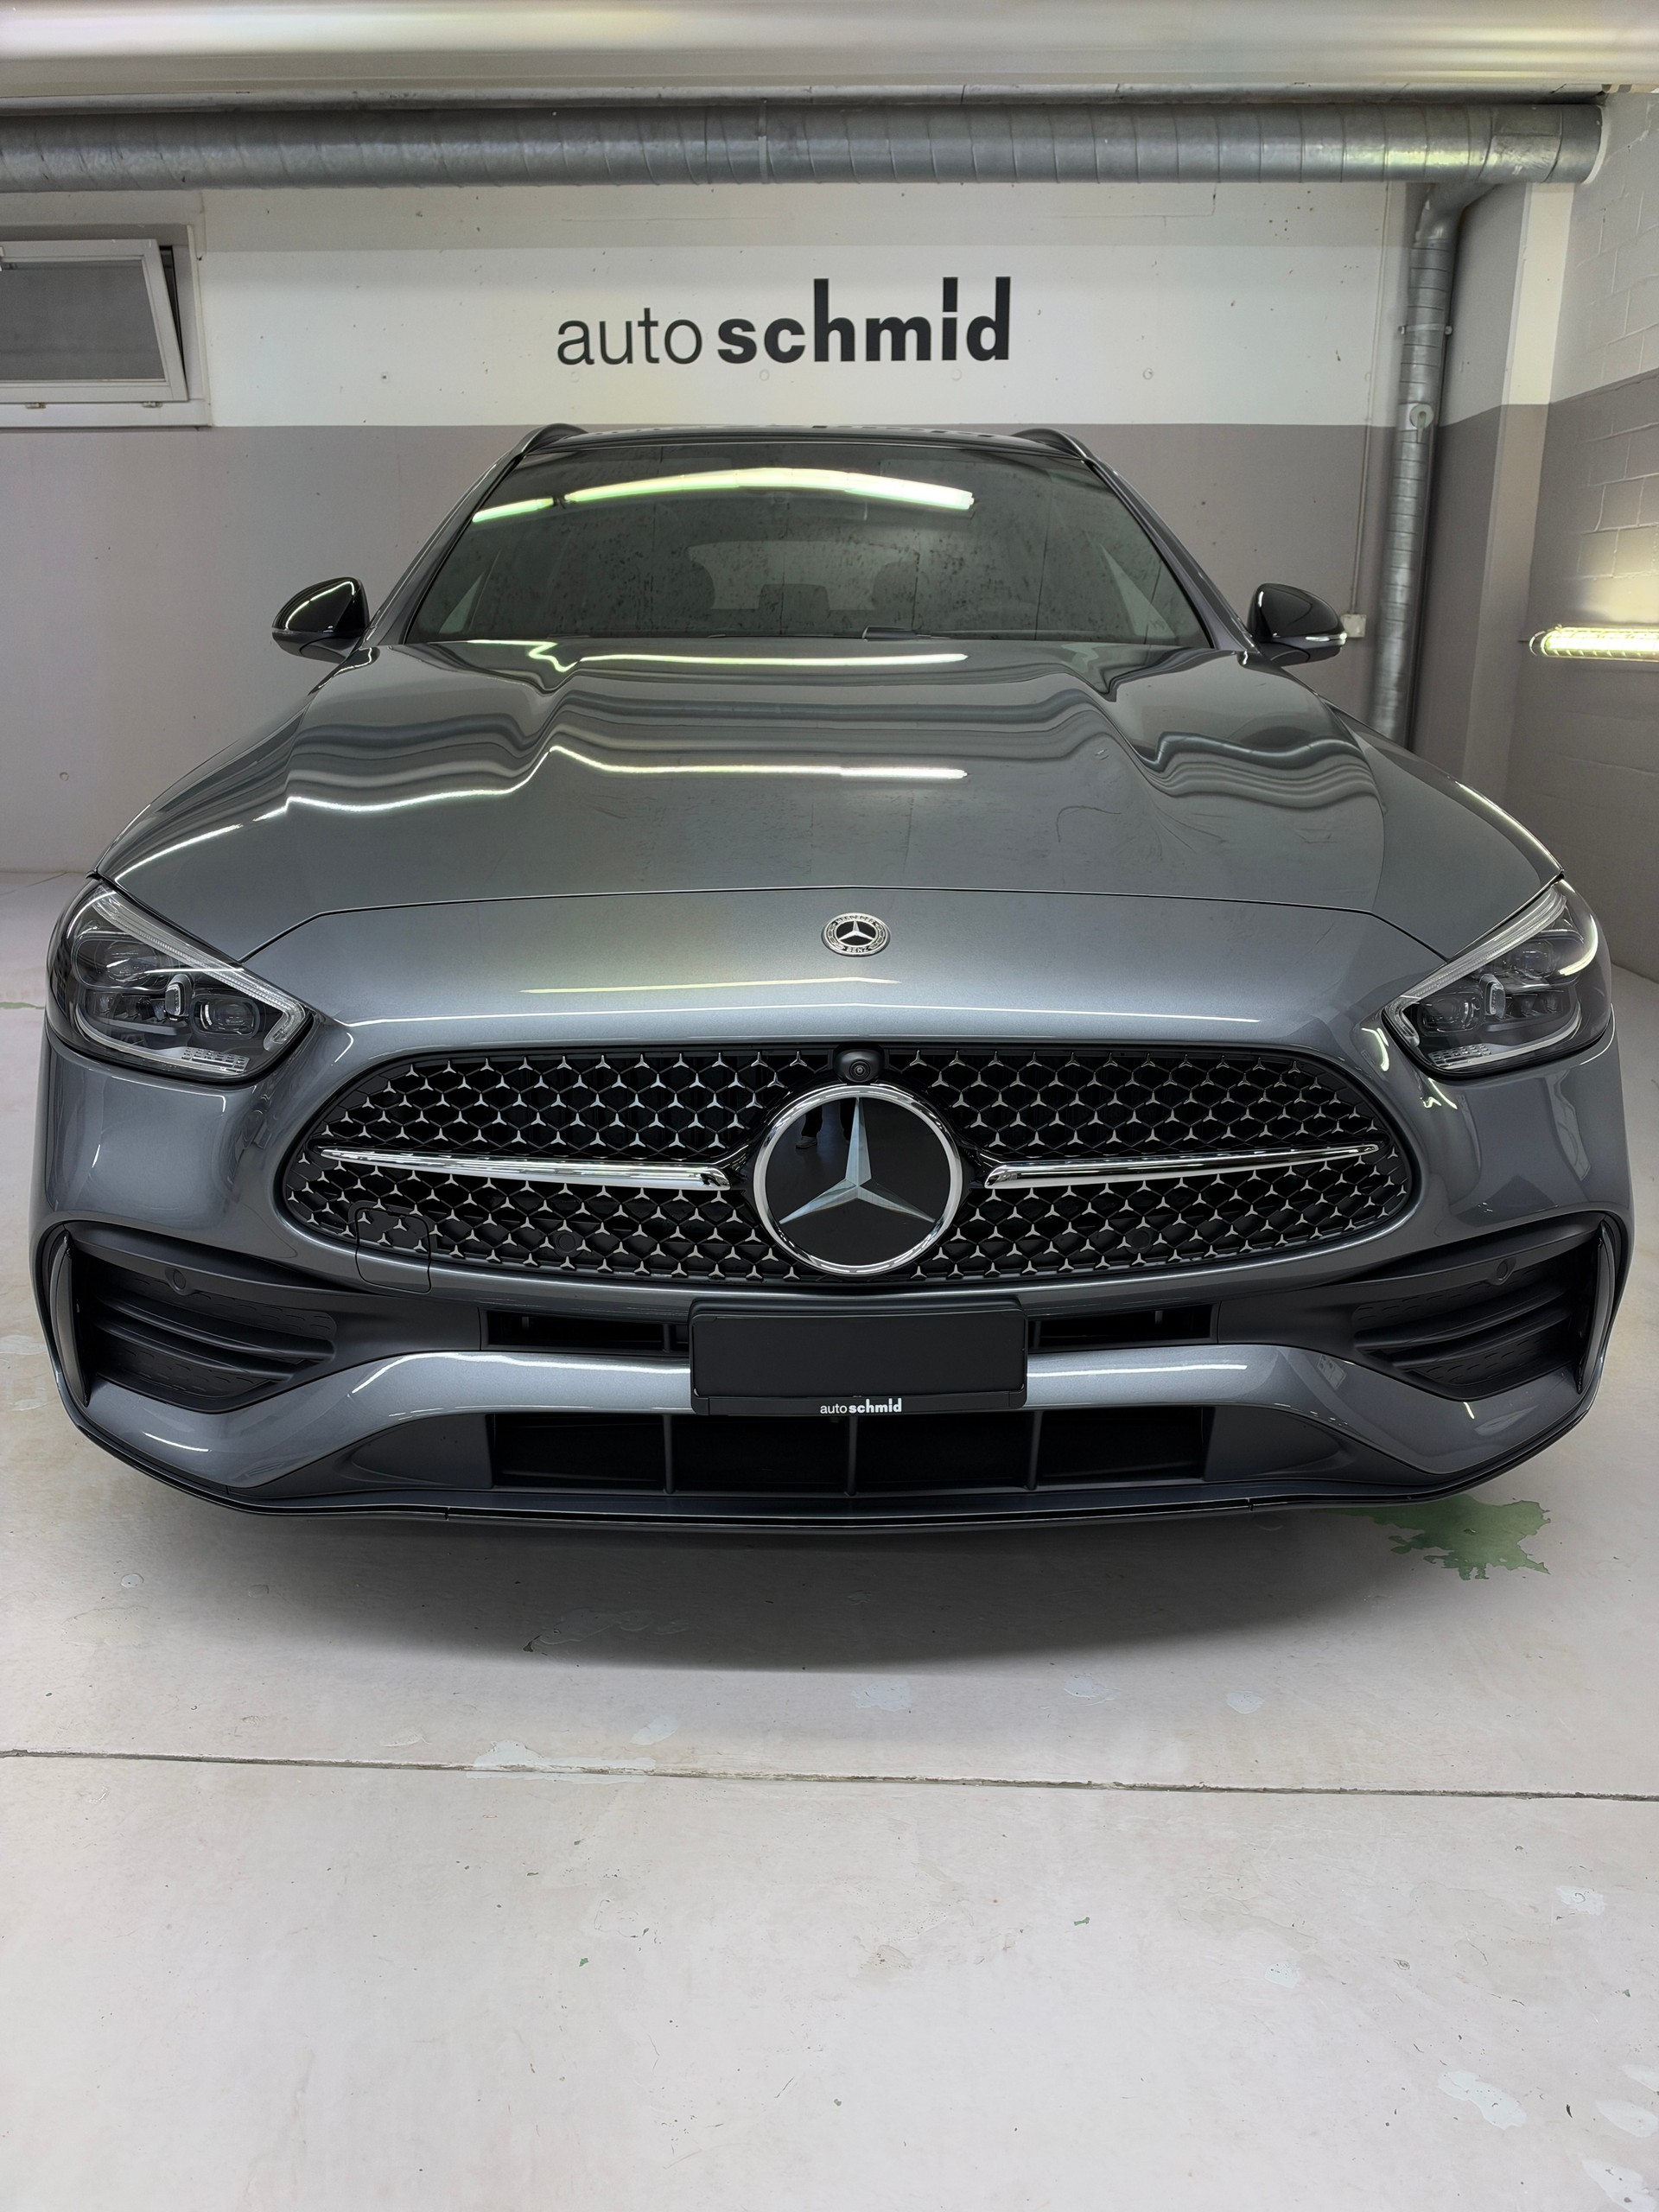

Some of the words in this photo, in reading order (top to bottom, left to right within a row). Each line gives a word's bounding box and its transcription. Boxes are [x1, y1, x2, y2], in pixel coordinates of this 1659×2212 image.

[557, 308, 702, 365] auto
[717, 276, 1011, 364] schmid
[820, 1403, 848, 1414] auto
[849, 1397, 902, 1414] schmid
